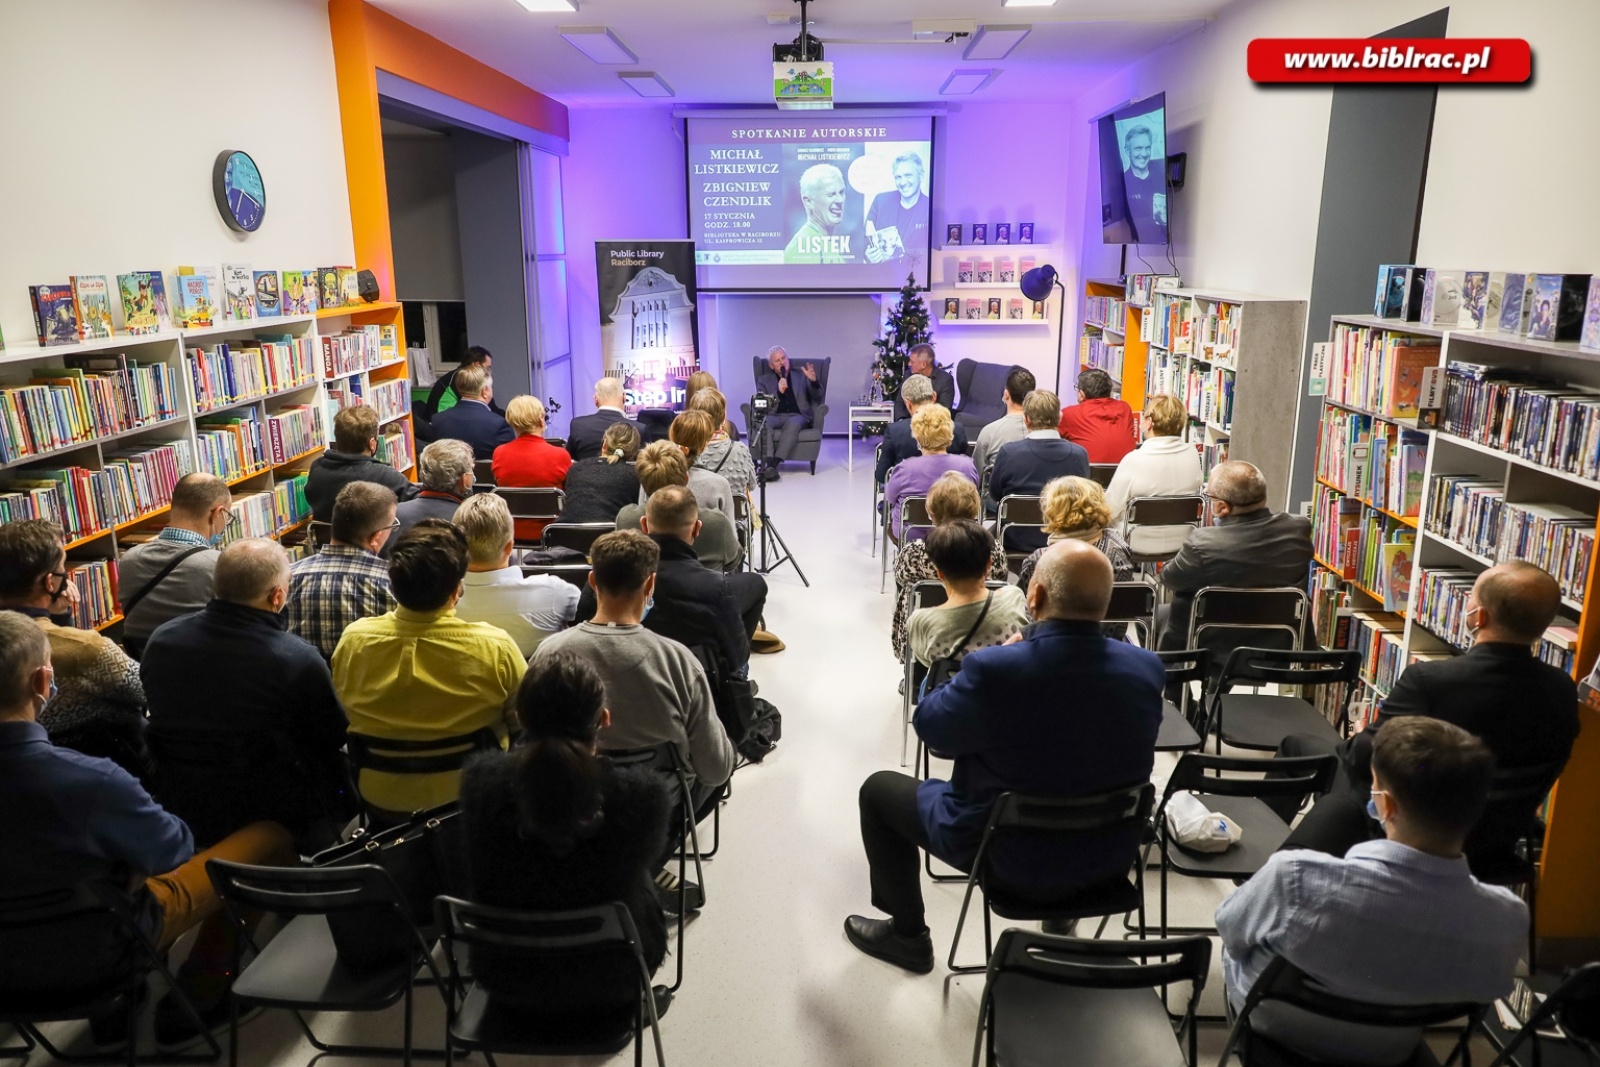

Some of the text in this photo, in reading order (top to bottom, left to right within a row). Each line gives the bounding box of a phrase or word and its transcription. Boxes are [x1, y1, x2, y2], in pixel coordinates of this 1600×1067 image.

[731, 127, 887, 139] SPOTKANIE AUTORSKIE
[710, 149, 764, 160] MICHAŁ
[694, 163, 780, 174] LISTKIEWICZ
[702, 182, 771, 192] ZBIGNIEW
[703, 196, 772, 206] CZENDLIK
[797, 236, 851, 254] LISTEK
[610, 250, 664, 259] Public Library
[611, 258, 646, 266] Raciborz
[323, 343, 332, 372] MANGA
[624, 388, 668, 408] Step
[1428, 386, 1436, 407] FILMY
[1354, 465, 1363, 497] RYSUNEK
